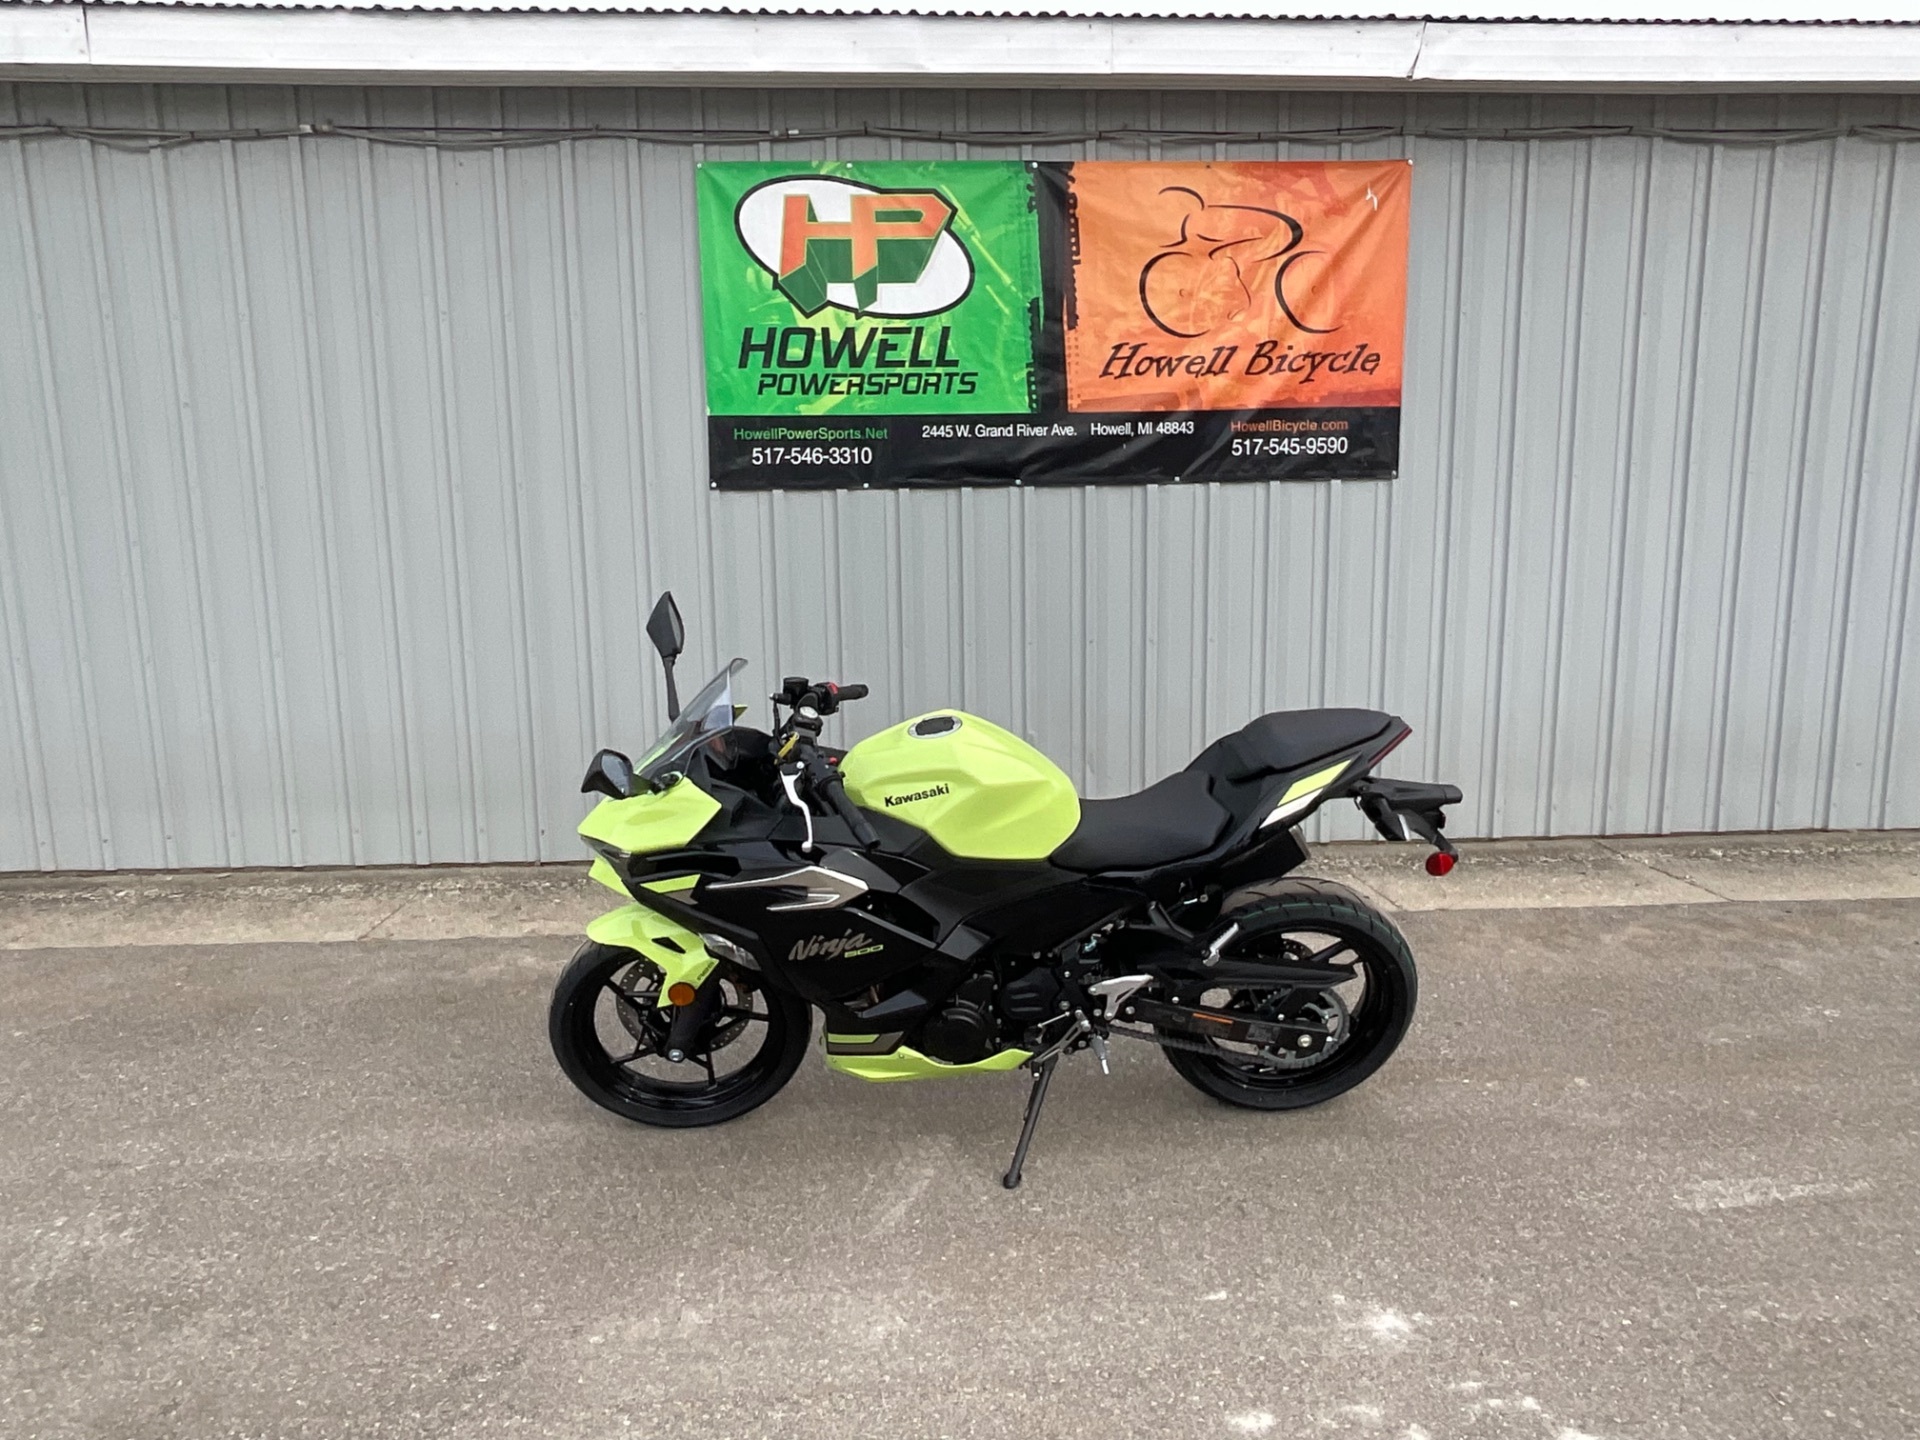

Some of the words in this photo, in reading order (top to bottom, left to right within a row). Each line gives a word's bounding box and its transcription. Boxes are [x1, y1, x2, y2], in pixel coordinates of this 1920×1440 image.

[778, 193, 952, 312] HP
[738, 326, 960, 369] HOWELL
[1099, 342, 1238, 379] Howell
[1244, 340, 1381, 384] Bicycle
[757, 371, 979, 396] POWERSPORTS
[733, 427, 888, 441] HowellPowerSports.Net
[921, 425, 953, 438] 2445
[956, 424, 972, 438] W.
[974, 423, 1013, 438] Grand
[1016, 423, 1048, 437] River
[1051, 423, 1078, 437] Ave.
[1090, 422, 1135, 437] Howell,
[1137, 422, 1153, 435] MI
[1155, 421, 1195, 435] 48843
[1230, 419, 1349, 435] HowellBicycle.com
[751, 446, 873, 466] 517-546-3310
[1231, 436, 1349, 457] 517-545-9590
[884, 783, 949, 807] Kawasaki
[788, 928, 873, 961] Ninja
